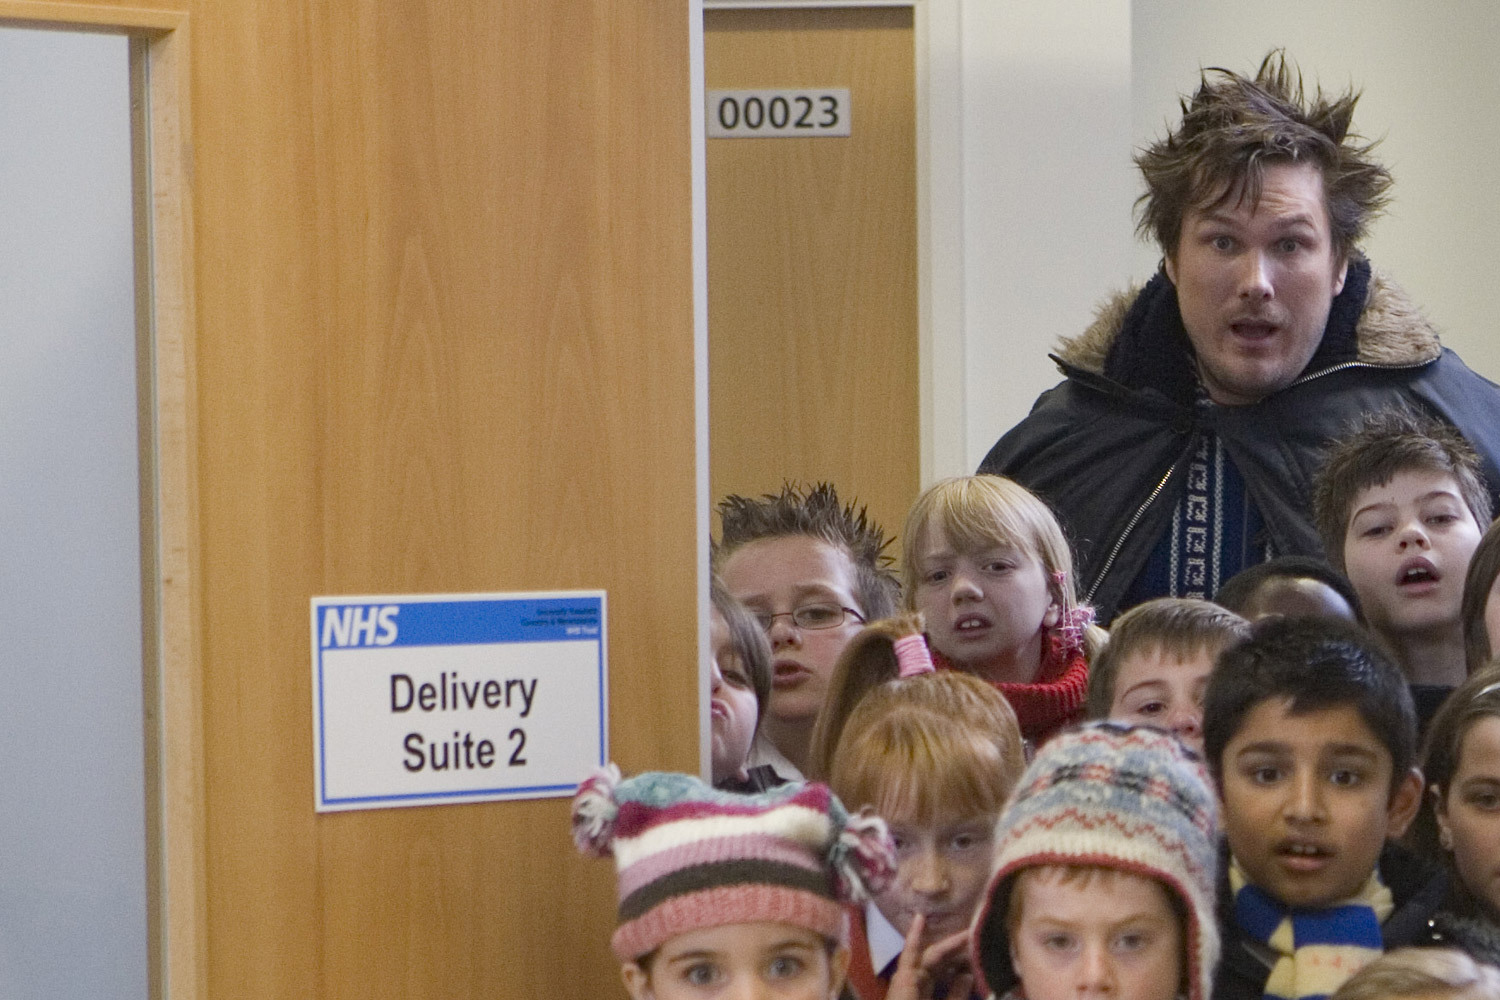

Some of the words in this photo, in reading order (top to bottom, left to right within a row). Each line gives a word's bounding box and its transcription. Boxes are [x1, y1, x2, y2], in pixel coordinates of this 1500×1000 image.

[718, 96, 839, 130] 00023
[321, 606, 400, 647] NHS
[390, 672, 538, 718] Delivery
[403, 731, 495, 773] Suite
[508, 728, 527, 767] 2
